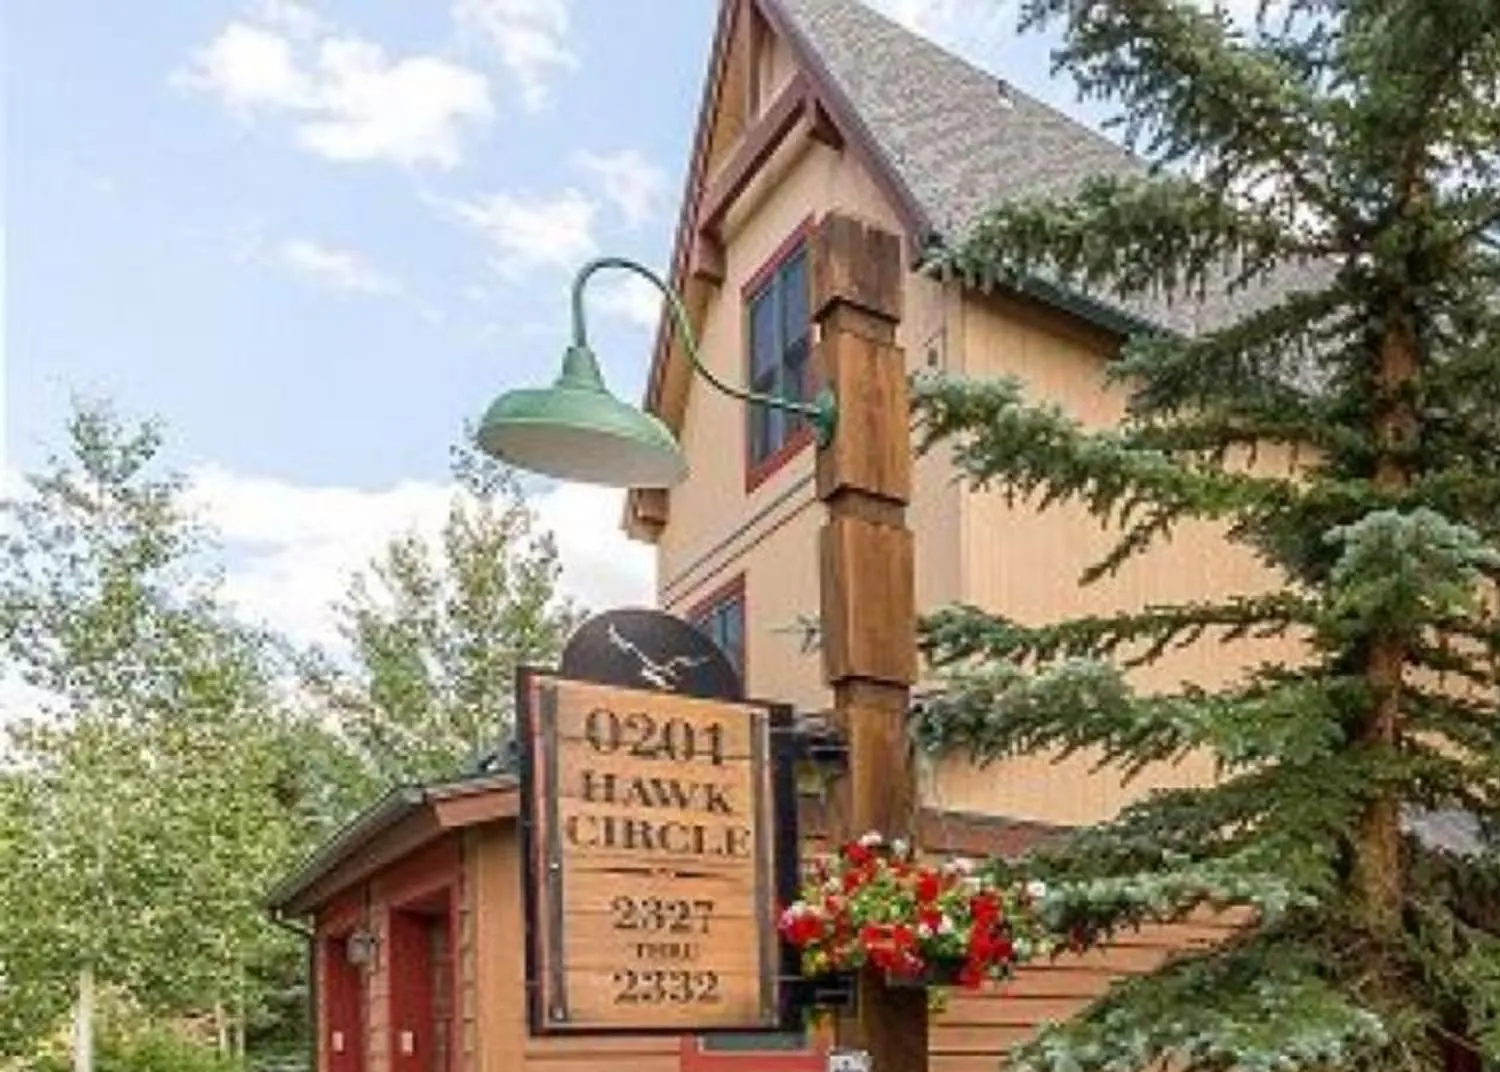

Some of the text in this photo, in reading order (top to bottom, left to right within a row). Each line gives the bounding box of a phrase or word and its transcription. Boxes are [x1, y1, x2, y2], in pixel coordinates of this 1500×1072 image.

[585, 706, 724, 766] 0201
[580, 769, 734, 816] HAWK
[566, 814, 752, 857] CIRCLE
